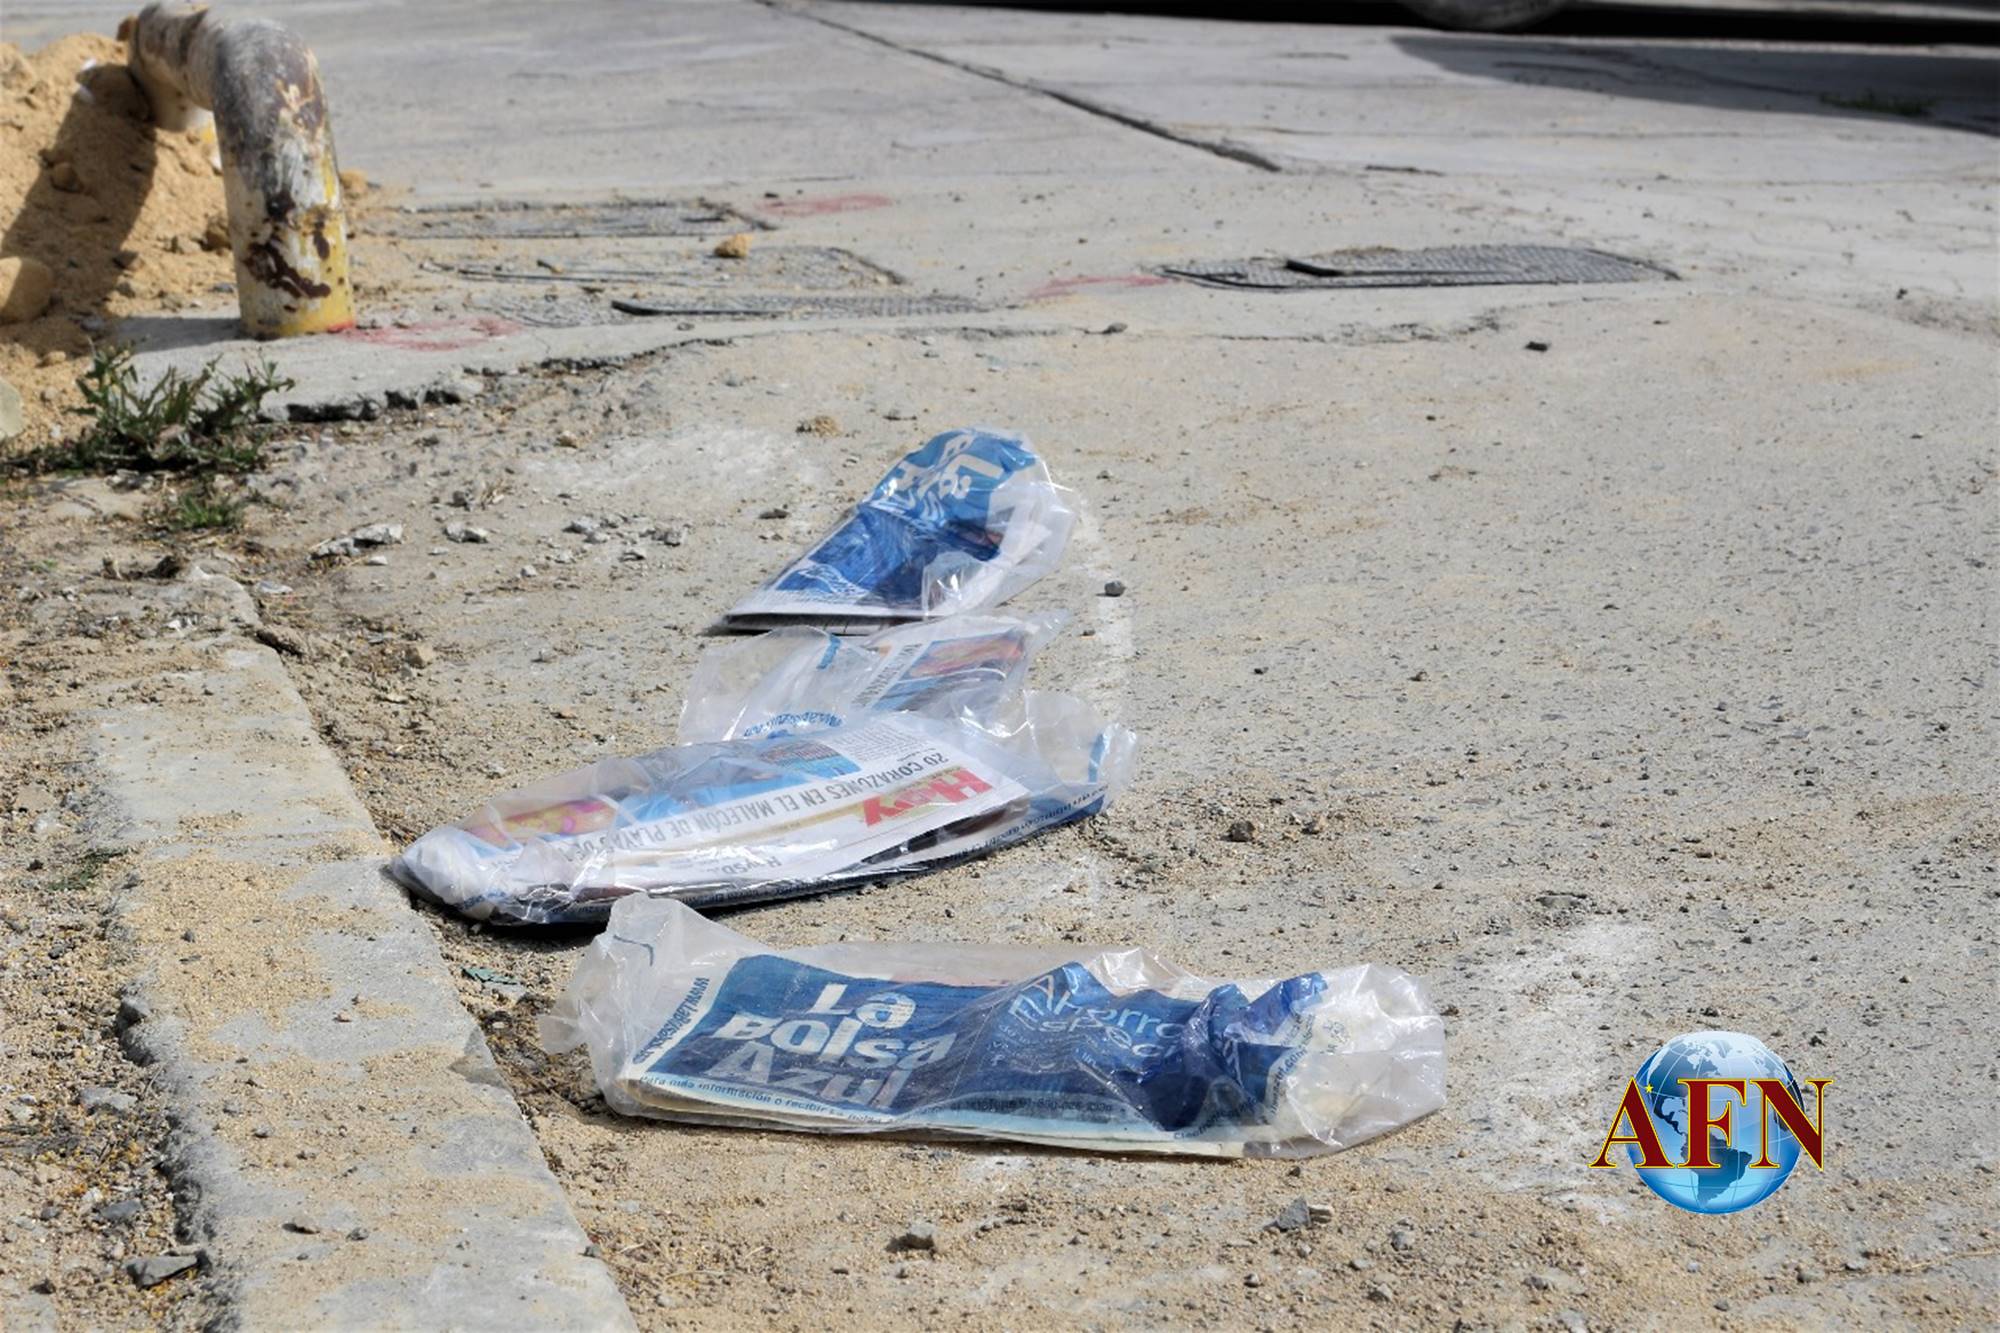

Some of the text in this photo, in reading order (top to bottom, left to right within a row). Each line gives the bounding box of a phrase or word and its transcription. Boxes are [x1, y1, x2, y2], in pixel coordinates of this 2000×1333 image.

[776, 793, 800, 821] EL
[797, 788, 826, 815] EN
[665, 819, 692, 843] DE
[806, 983, 916, 1029] La
[712, 1012, 957, 1070] Bolsa
[703, 1041, 913, 1111] Azul
